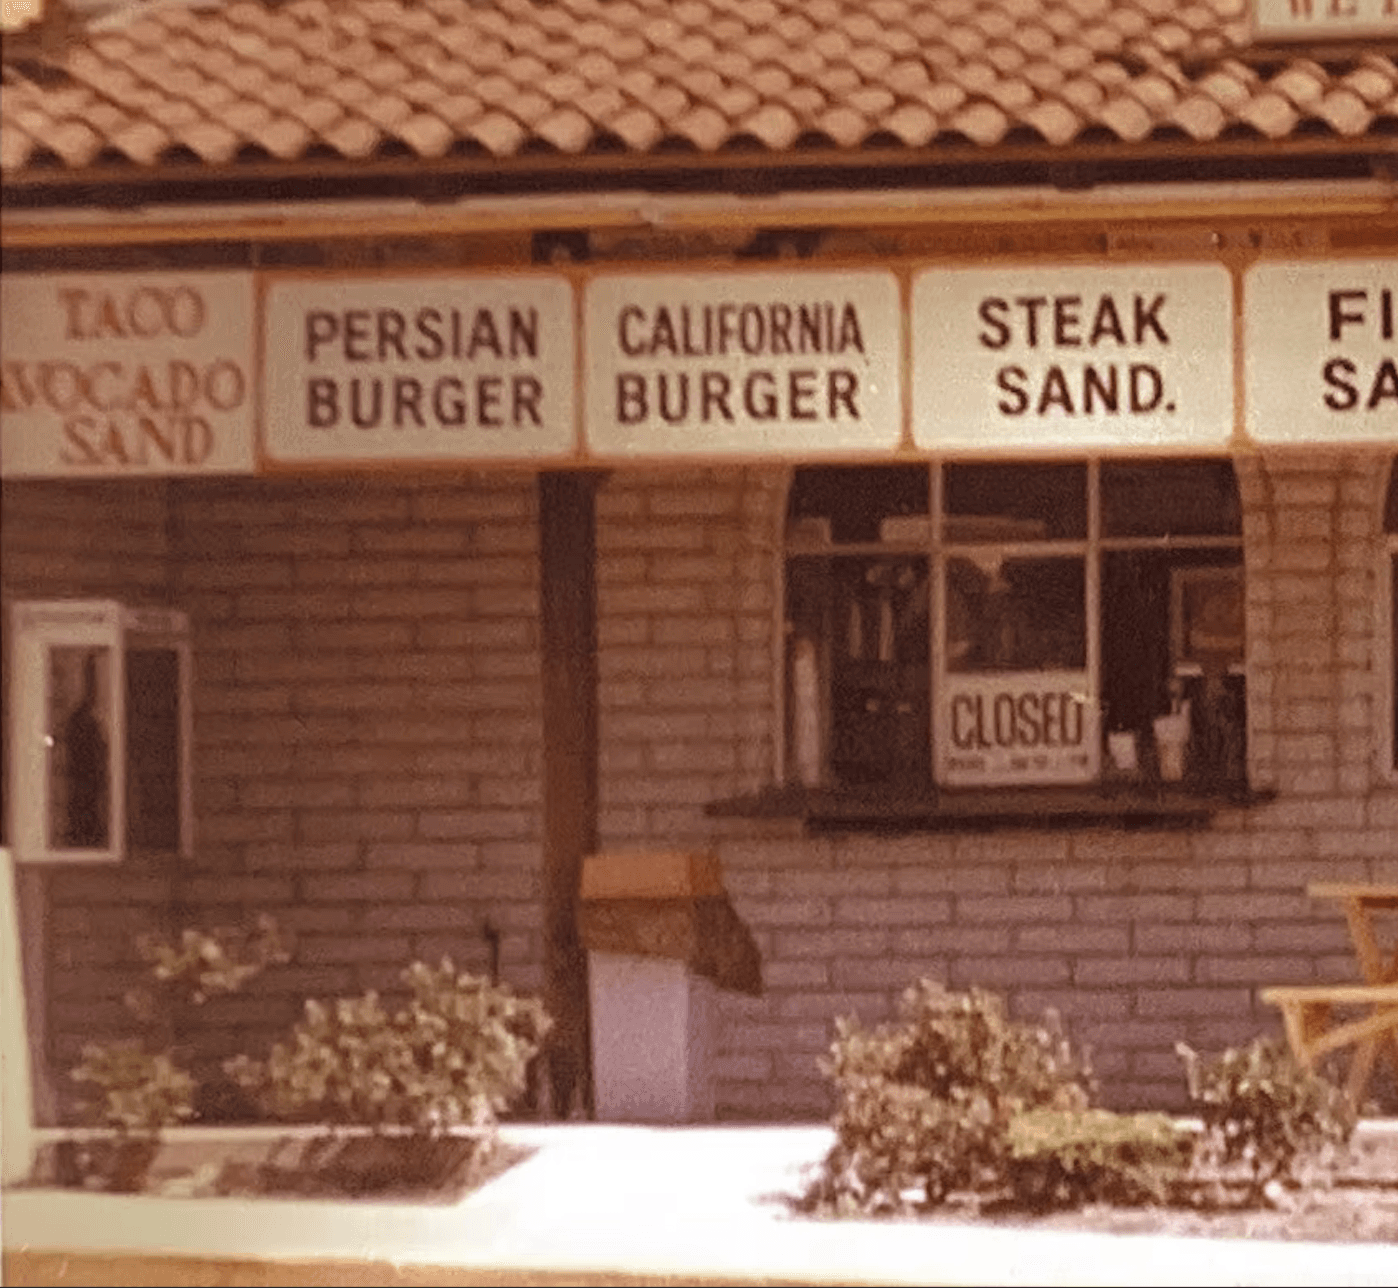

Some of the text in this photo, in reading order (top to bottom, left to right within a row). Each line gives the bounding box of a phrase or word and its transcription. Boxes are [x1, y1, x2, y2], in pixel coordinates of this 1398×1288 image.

[57, 285, 206, 340] TACO
[304, 308, 540, 359] PERSIAN
[616, 302, 865, 357] CALIFORNIA
[977, 294, 1171, 350] STEAK
[307, 375, 543, 428] BURGER
[615, 369, 861, 424] BURGER
[996, 364, 1177, 417] SAND.
[59, 416, 215, 466] SAND
[952, 692, 1084, 749] CLOSED
